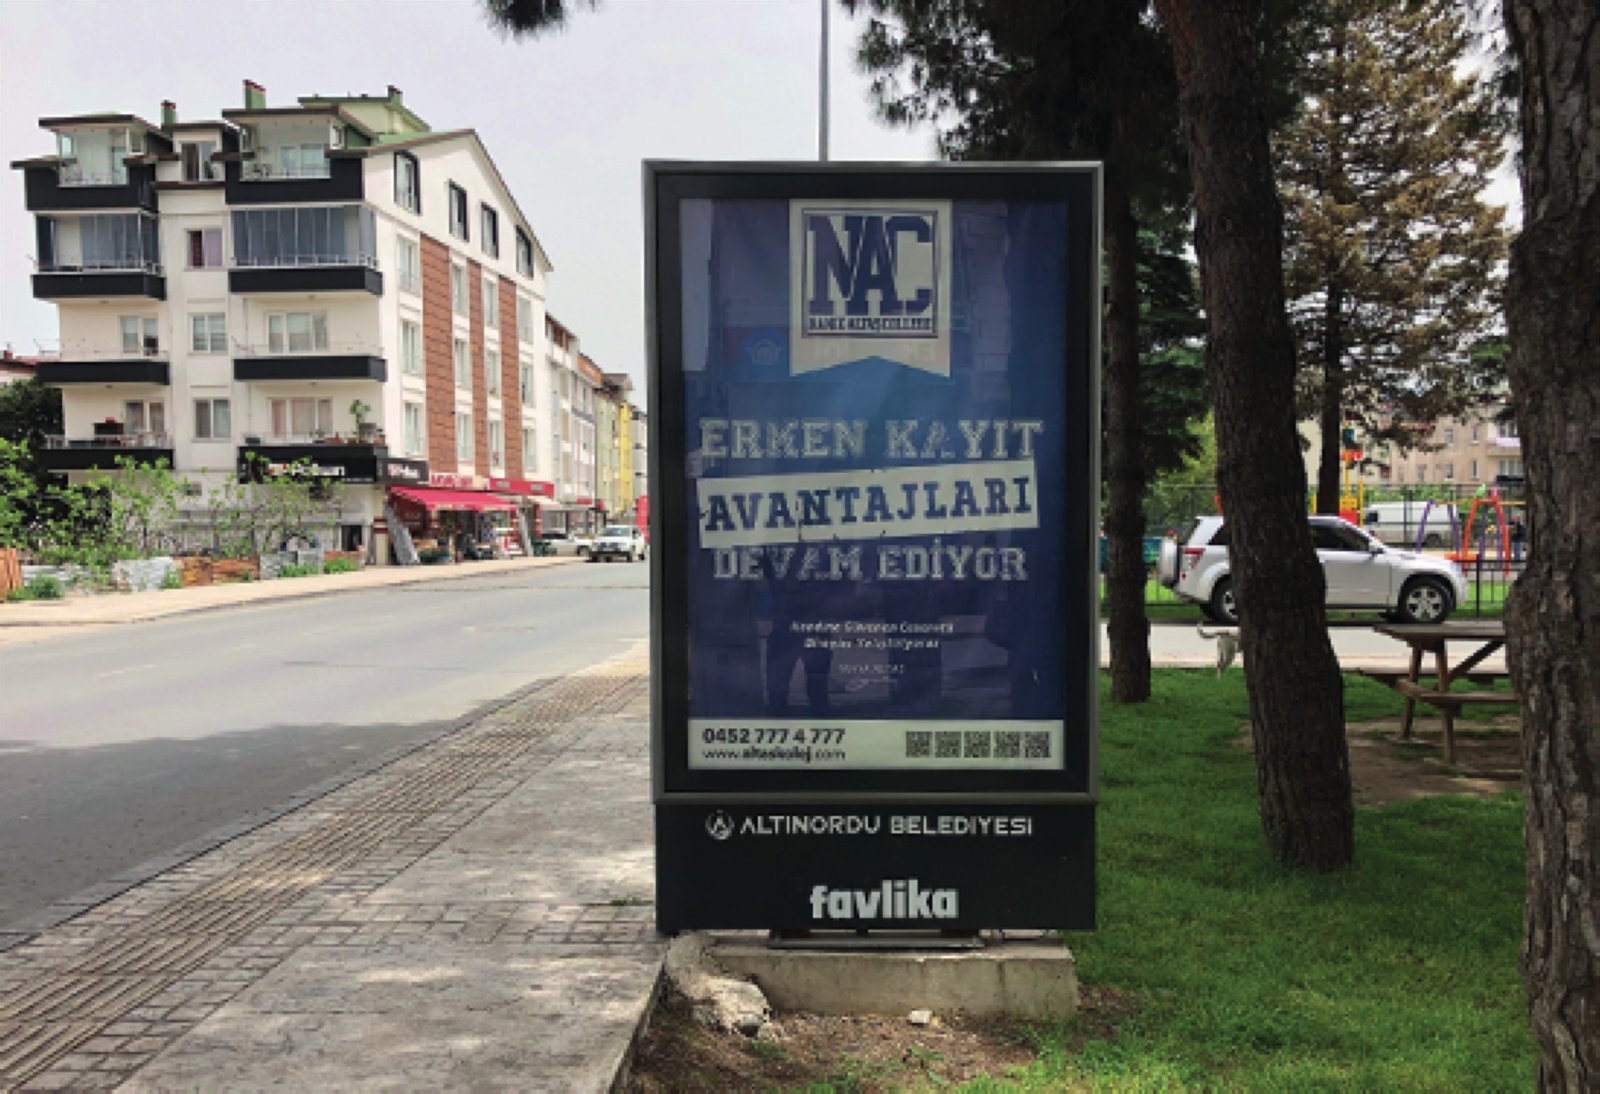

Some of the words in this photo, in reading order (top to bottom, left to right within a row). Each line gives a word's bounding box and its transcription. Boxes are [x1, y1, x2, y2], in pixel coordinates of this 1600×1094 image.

[808, 216, 933, 316] NAC
[700, 420, 865, 459] ERKEN
[885, 420, 1043, 459] KAYIT
[705, 476, 1033, 532] AVANTAJLARI
[713, 546, 863, 581] DEVAM
[877, 538, 1028, 581] EDİYOR
[702, 728, 750, 744] 0452
[754, 728, 790, 744] 777
[792, 728, 806, 744] 4
[810, 728, 846, 744] 777
[740, 815, 881, 835] ALTINORDU
[810, 878, 959, 919] favlika
